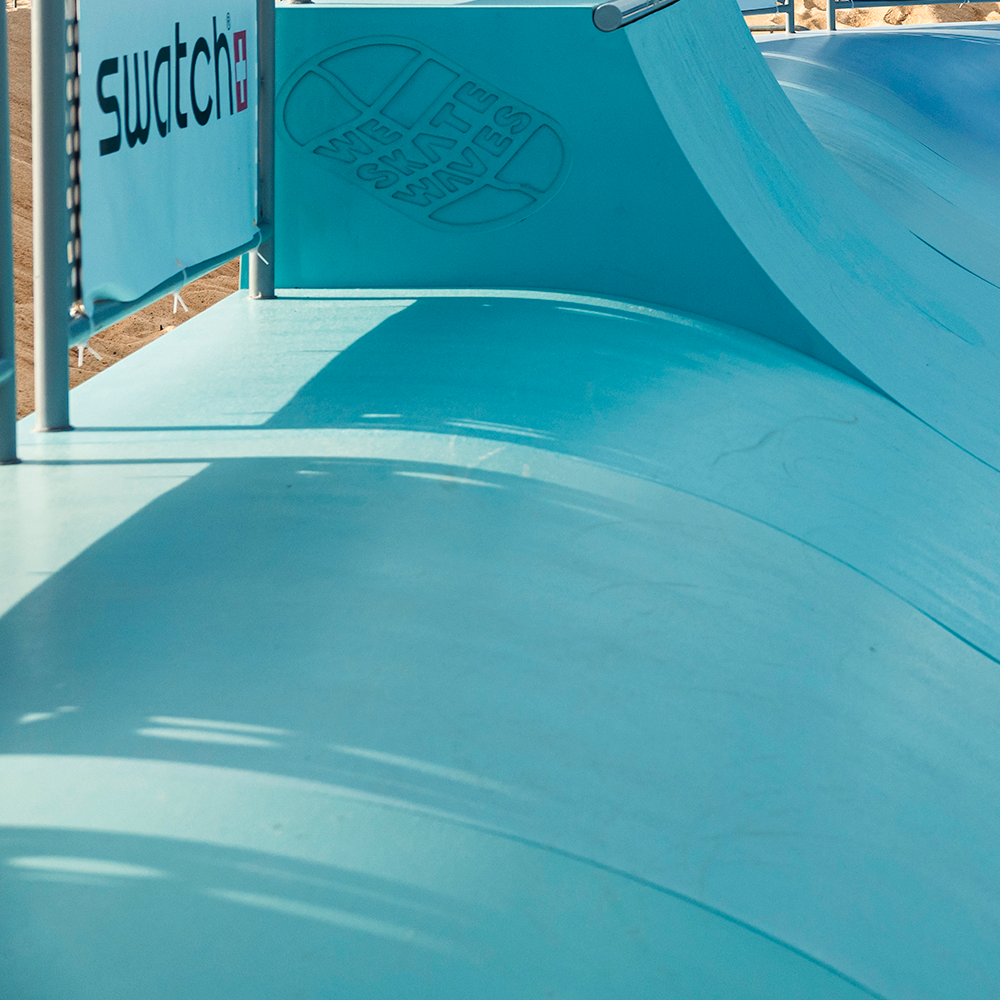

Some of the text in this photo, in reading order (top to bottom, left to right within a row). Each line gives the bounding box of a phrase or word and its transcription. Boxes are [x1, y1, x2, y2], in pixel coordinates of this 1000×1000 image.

[96, 16, 234, 157] swatch
[356, 80, 500, 190] SKATE
[312, 118, 403, 165] WE
[391, 105, 533, 208] WAVES
